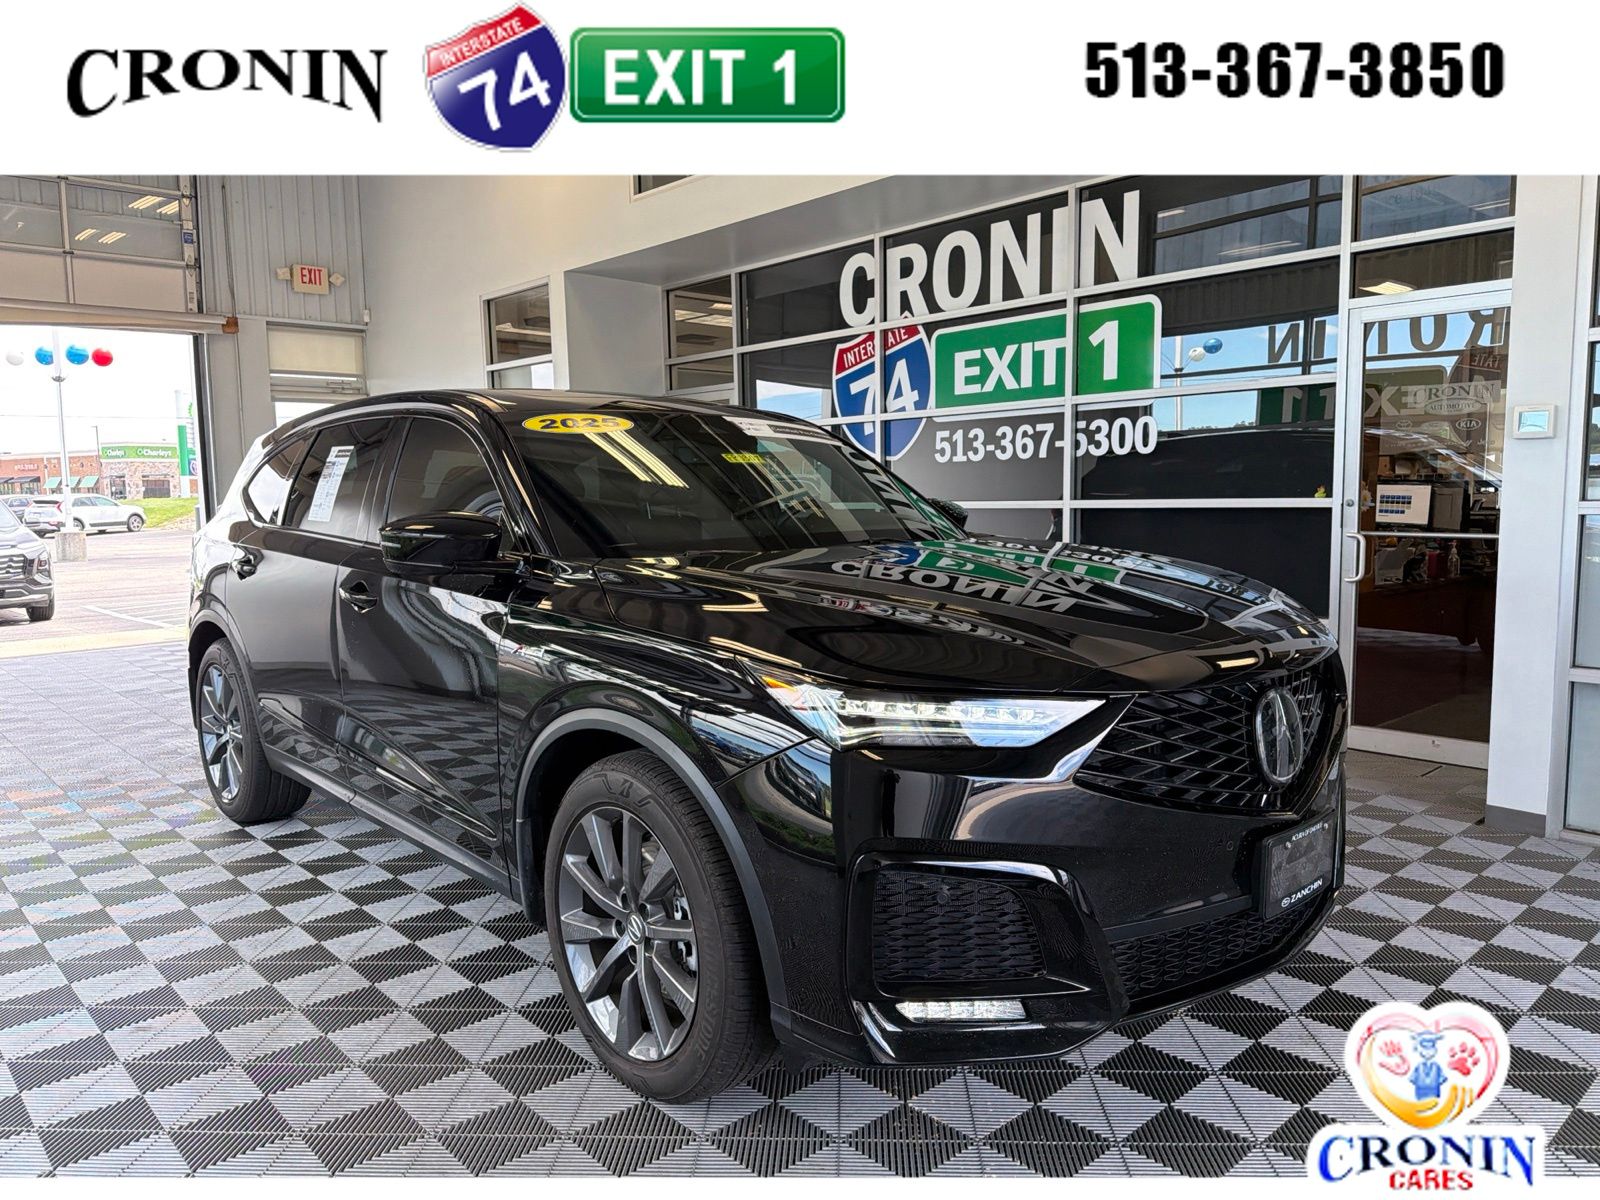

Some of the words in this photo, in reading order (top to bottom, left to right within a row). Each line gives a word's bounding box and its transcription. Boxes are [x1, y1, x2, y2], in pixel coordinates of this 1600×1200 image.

[300, 267, 322, 286] EXIT
[840, 189, 1140, 328] CRONIN
[843, 328, 908, 368] INTERATE
[954, 336, 1067, 395] EXIT
[1088, 320, 1119, 381] 1
[849, 358, 919, 436] 74
[538, 418, 621, 430] 2025
[934, 415, 1158, 463] 513-367-5300
[1460, 420, 1477, 428] KIA
[1291, 878, 1322, 903] ZANCHIN
